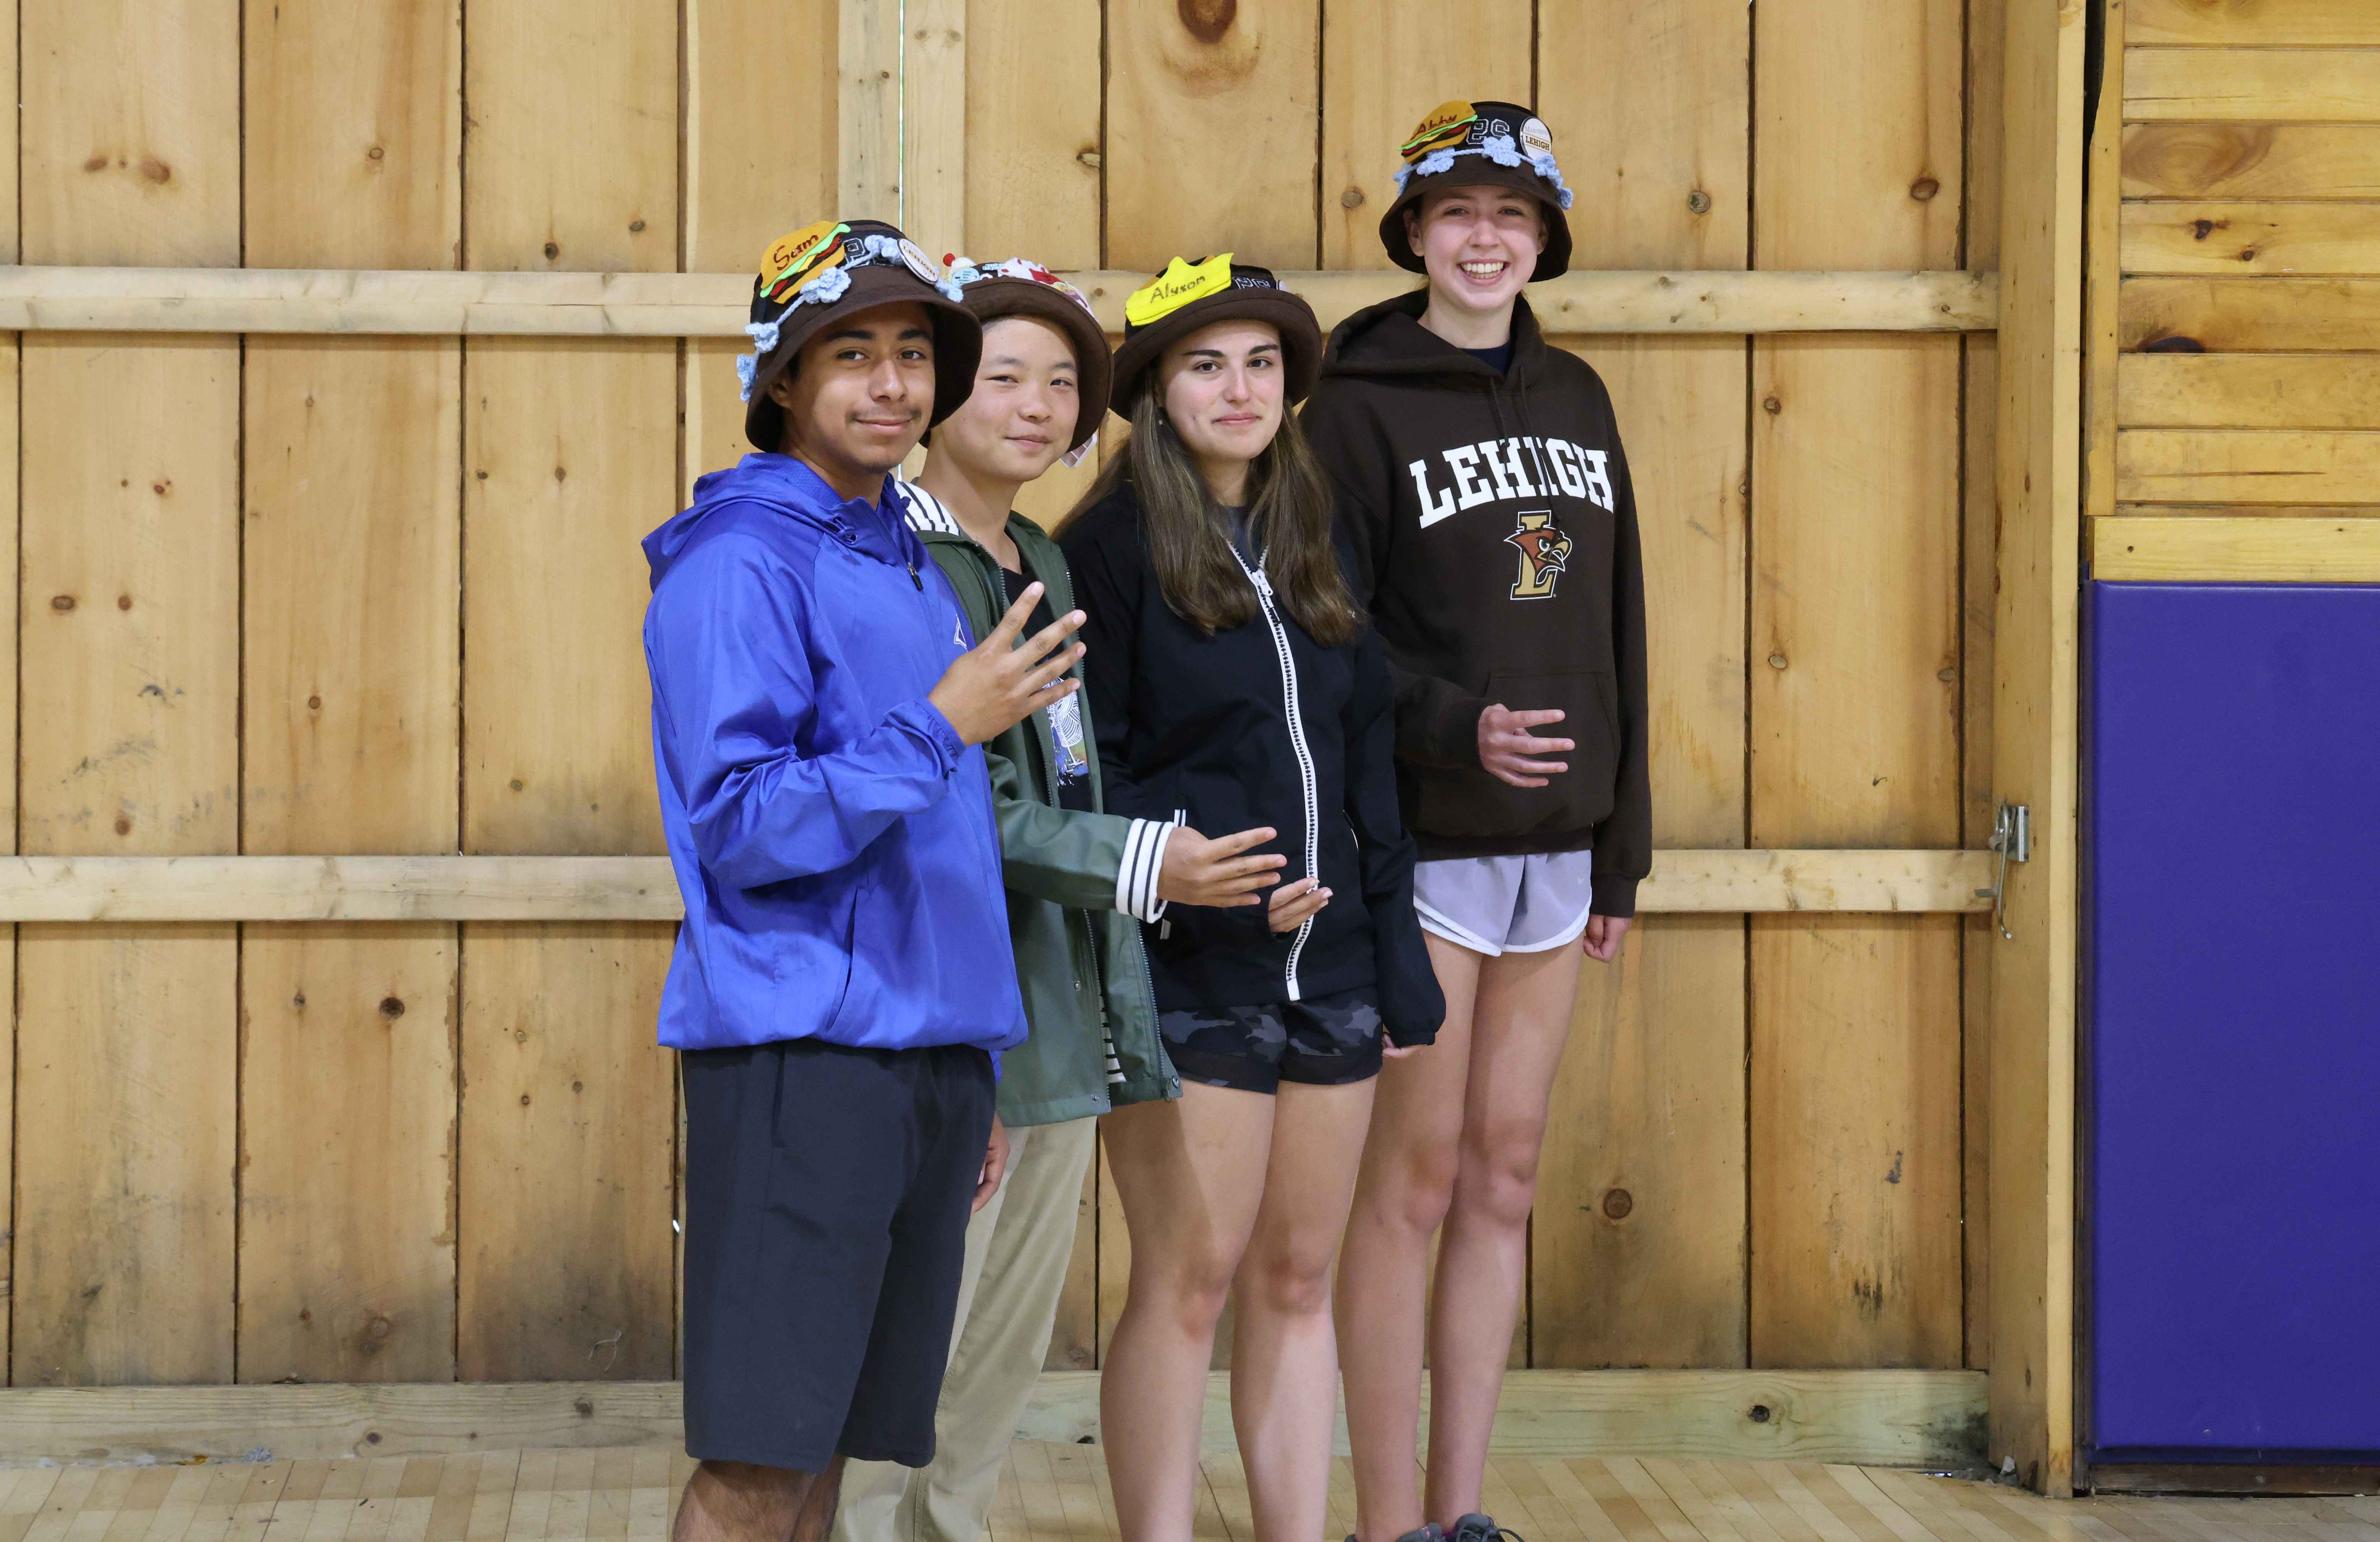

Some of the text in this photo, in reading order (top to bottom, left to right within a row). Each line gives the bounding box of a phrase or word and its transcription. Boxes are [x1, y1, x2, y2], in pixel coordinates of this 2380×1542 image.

[1525, 136, 1550, 151] LEHIGH
[773, 235, 819, 270] Sam
[903, 245, 936, 277] LEHIGH
[1150, 275, 1206, 304] Alyson
[1409, 436, 1614, 529] LEHIGH
